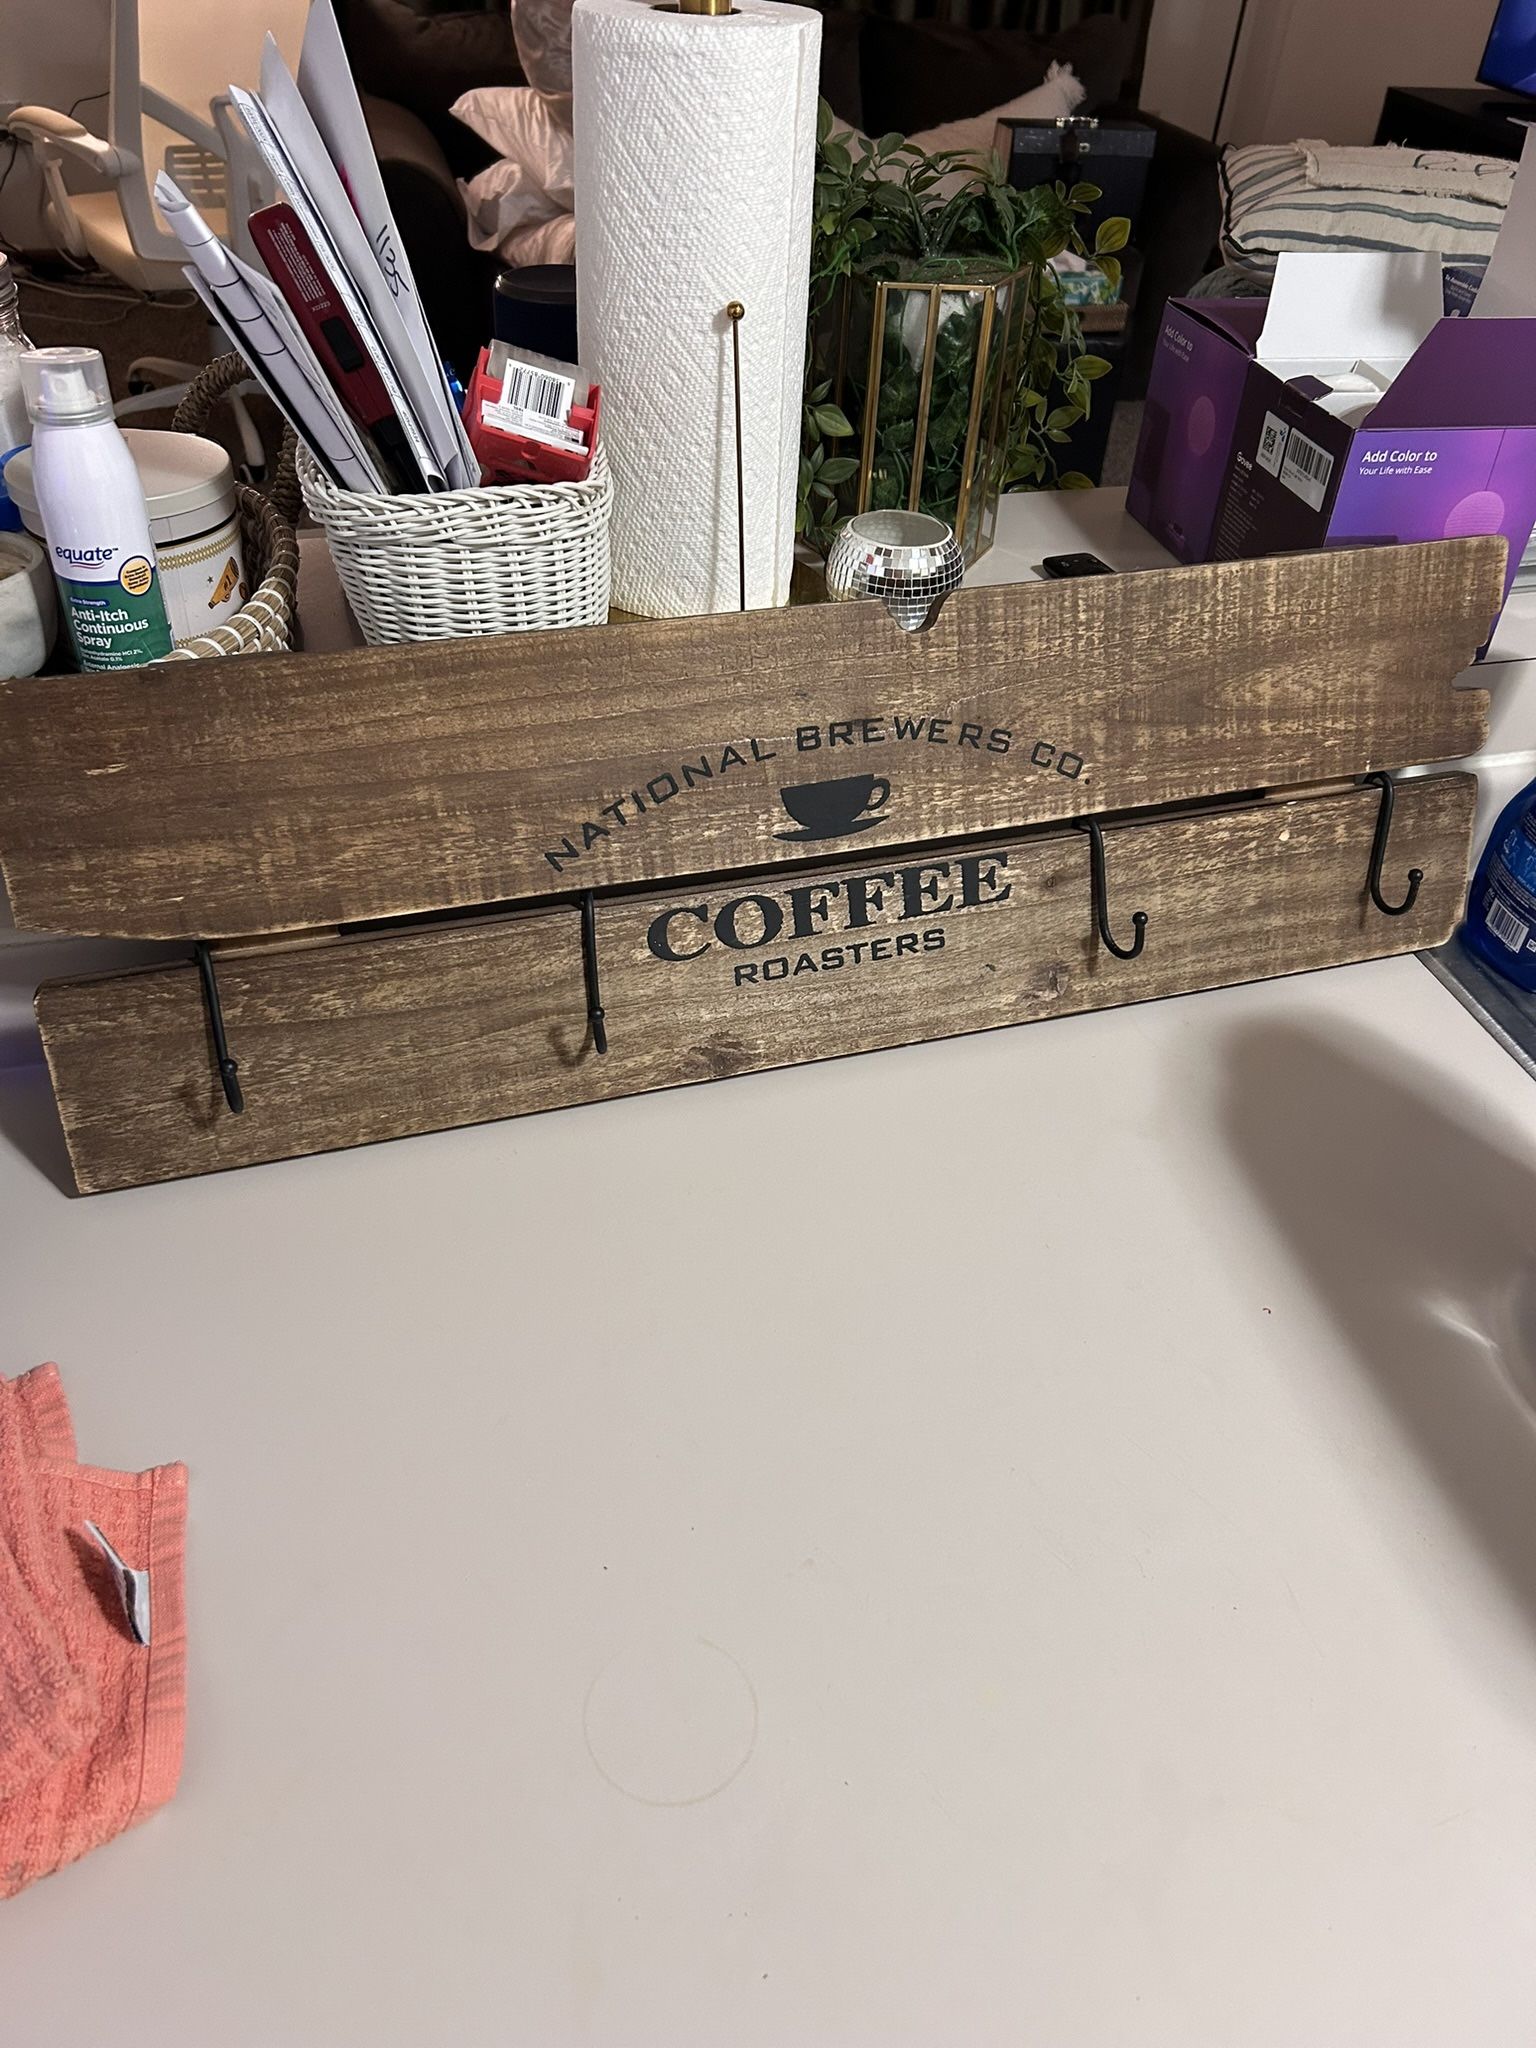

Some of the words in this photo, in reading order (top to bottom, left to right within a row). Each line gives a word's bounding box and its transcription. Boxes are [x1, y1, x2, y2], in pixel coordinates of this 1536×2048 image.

[1361, 450, 1388, 463] Add
[1389, 449, 1422, 462] Color
[1424, 450, 1438, 462] to
[1359, 466, 1378, 476] Your
[1379, 465, 1394, 476] Life
[1395, 465, 1413, 475] with
[1413, 465, 1433, 475] Ease
[55, 546, 113, 564] equate
[71, 606, 129, 622] Anti-Itch
[73, 618, 149, 635] Continuous
[76, 631, 112, 649] Spray
[544, 738, 777, 873] NATIONAL
[796, 717, 1012, 754] BREWERS
[1030, 740, 1091, 785] CO.
[646, 851, 1013, 963] COFFEE
[734, 927, 946, 987] ROASTERS
